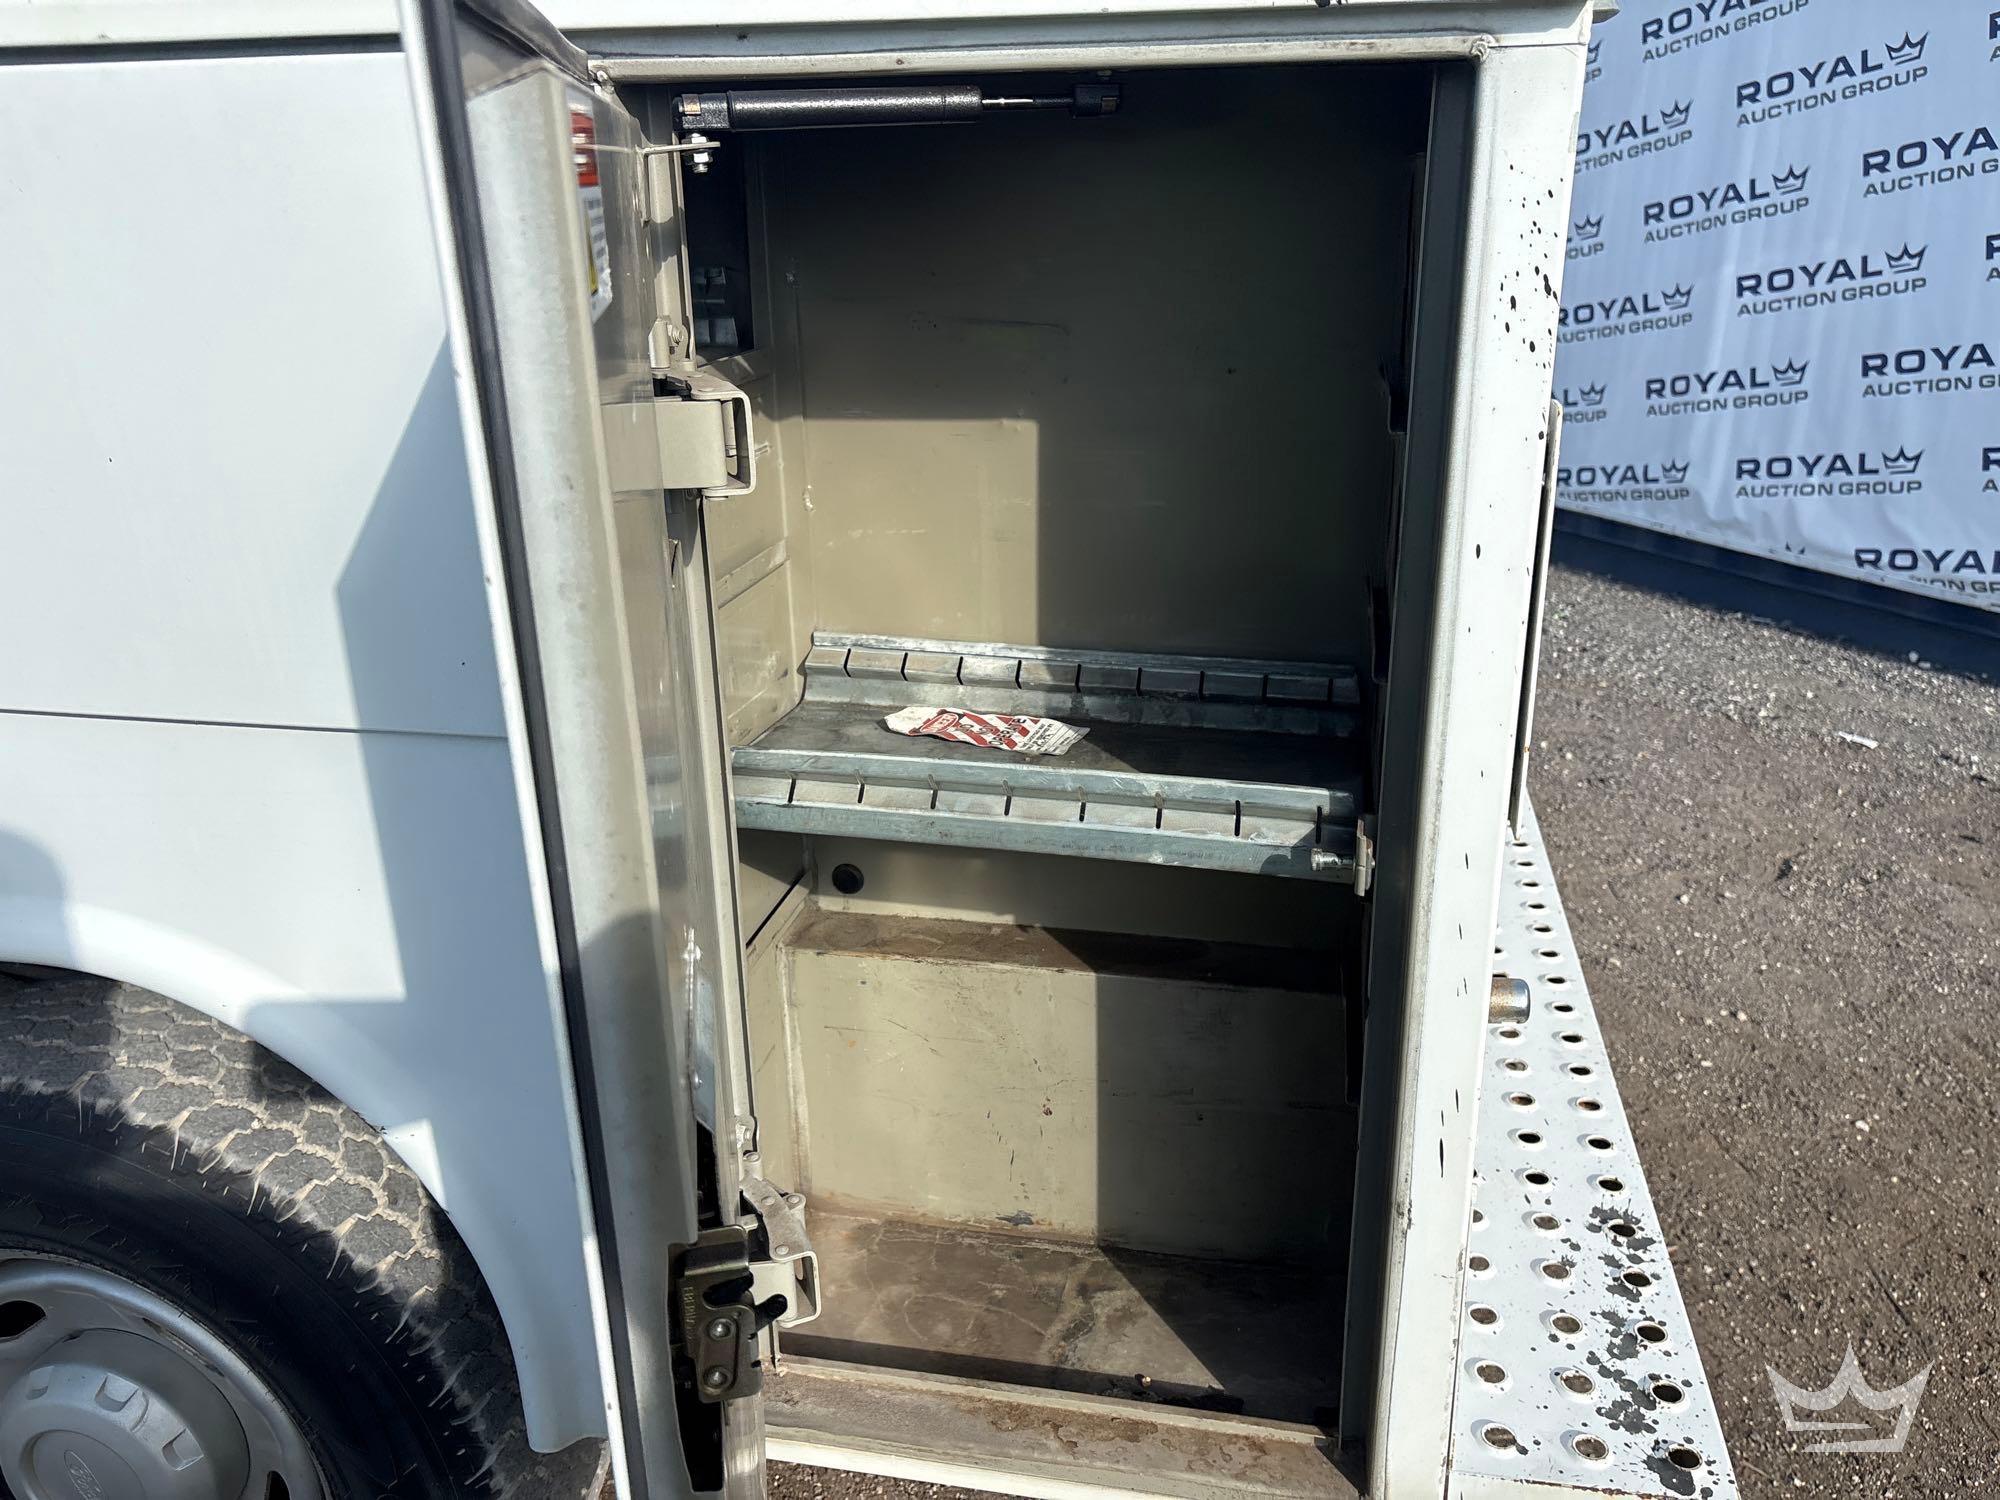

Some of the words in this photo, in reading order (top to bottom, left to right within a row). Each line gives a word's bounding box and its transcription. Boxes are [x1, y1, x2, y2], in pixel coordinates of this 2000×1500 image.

[1642, 23, 1729, 63] AUCTION
[1736, 50, 1884, 108] ROYAL
[1737, 91, 1836, 128] AUCTION
[1841, 66, 1928, 100] GROUP
[1627, 129, 1693, 160] GROUP
[1862, 126, 1999, 177] ROYA
[1863, 162, 1975, 198] AUCTION
[1643, 178, 1770, 227] ROYAL
[1643, 213, 1727, 244] AUCTION
[1731, 196, 1809, 225] GROUP
[1736, 254, 1883, 298] ROYAL
[1558, 293, 1660, 327] ROYAL
[1737, 290, 1836, 317] AUCTION
[1841, 276, 1927, 301] GROUP
[1628, 312, 1693, 334] GROUP
[1861, 343, 1996, 378] ROYA
[1646, 367, 1770, 400] ROYAL
[1862, 375, 1972, 398] AUCTION
[1646, 396, 1727, 417] AUCTION
[1733, 390, 1809, 410] GROUP
[1557, 464, 1660, 487] ROYAL
[1736, 453, 1879, 480] ROYAL
[1631, 487, 1690, 501] GROUP
[1736, 482, 1833, 498] AUCTION
[1838, 480, 1922, 495] GROUP
